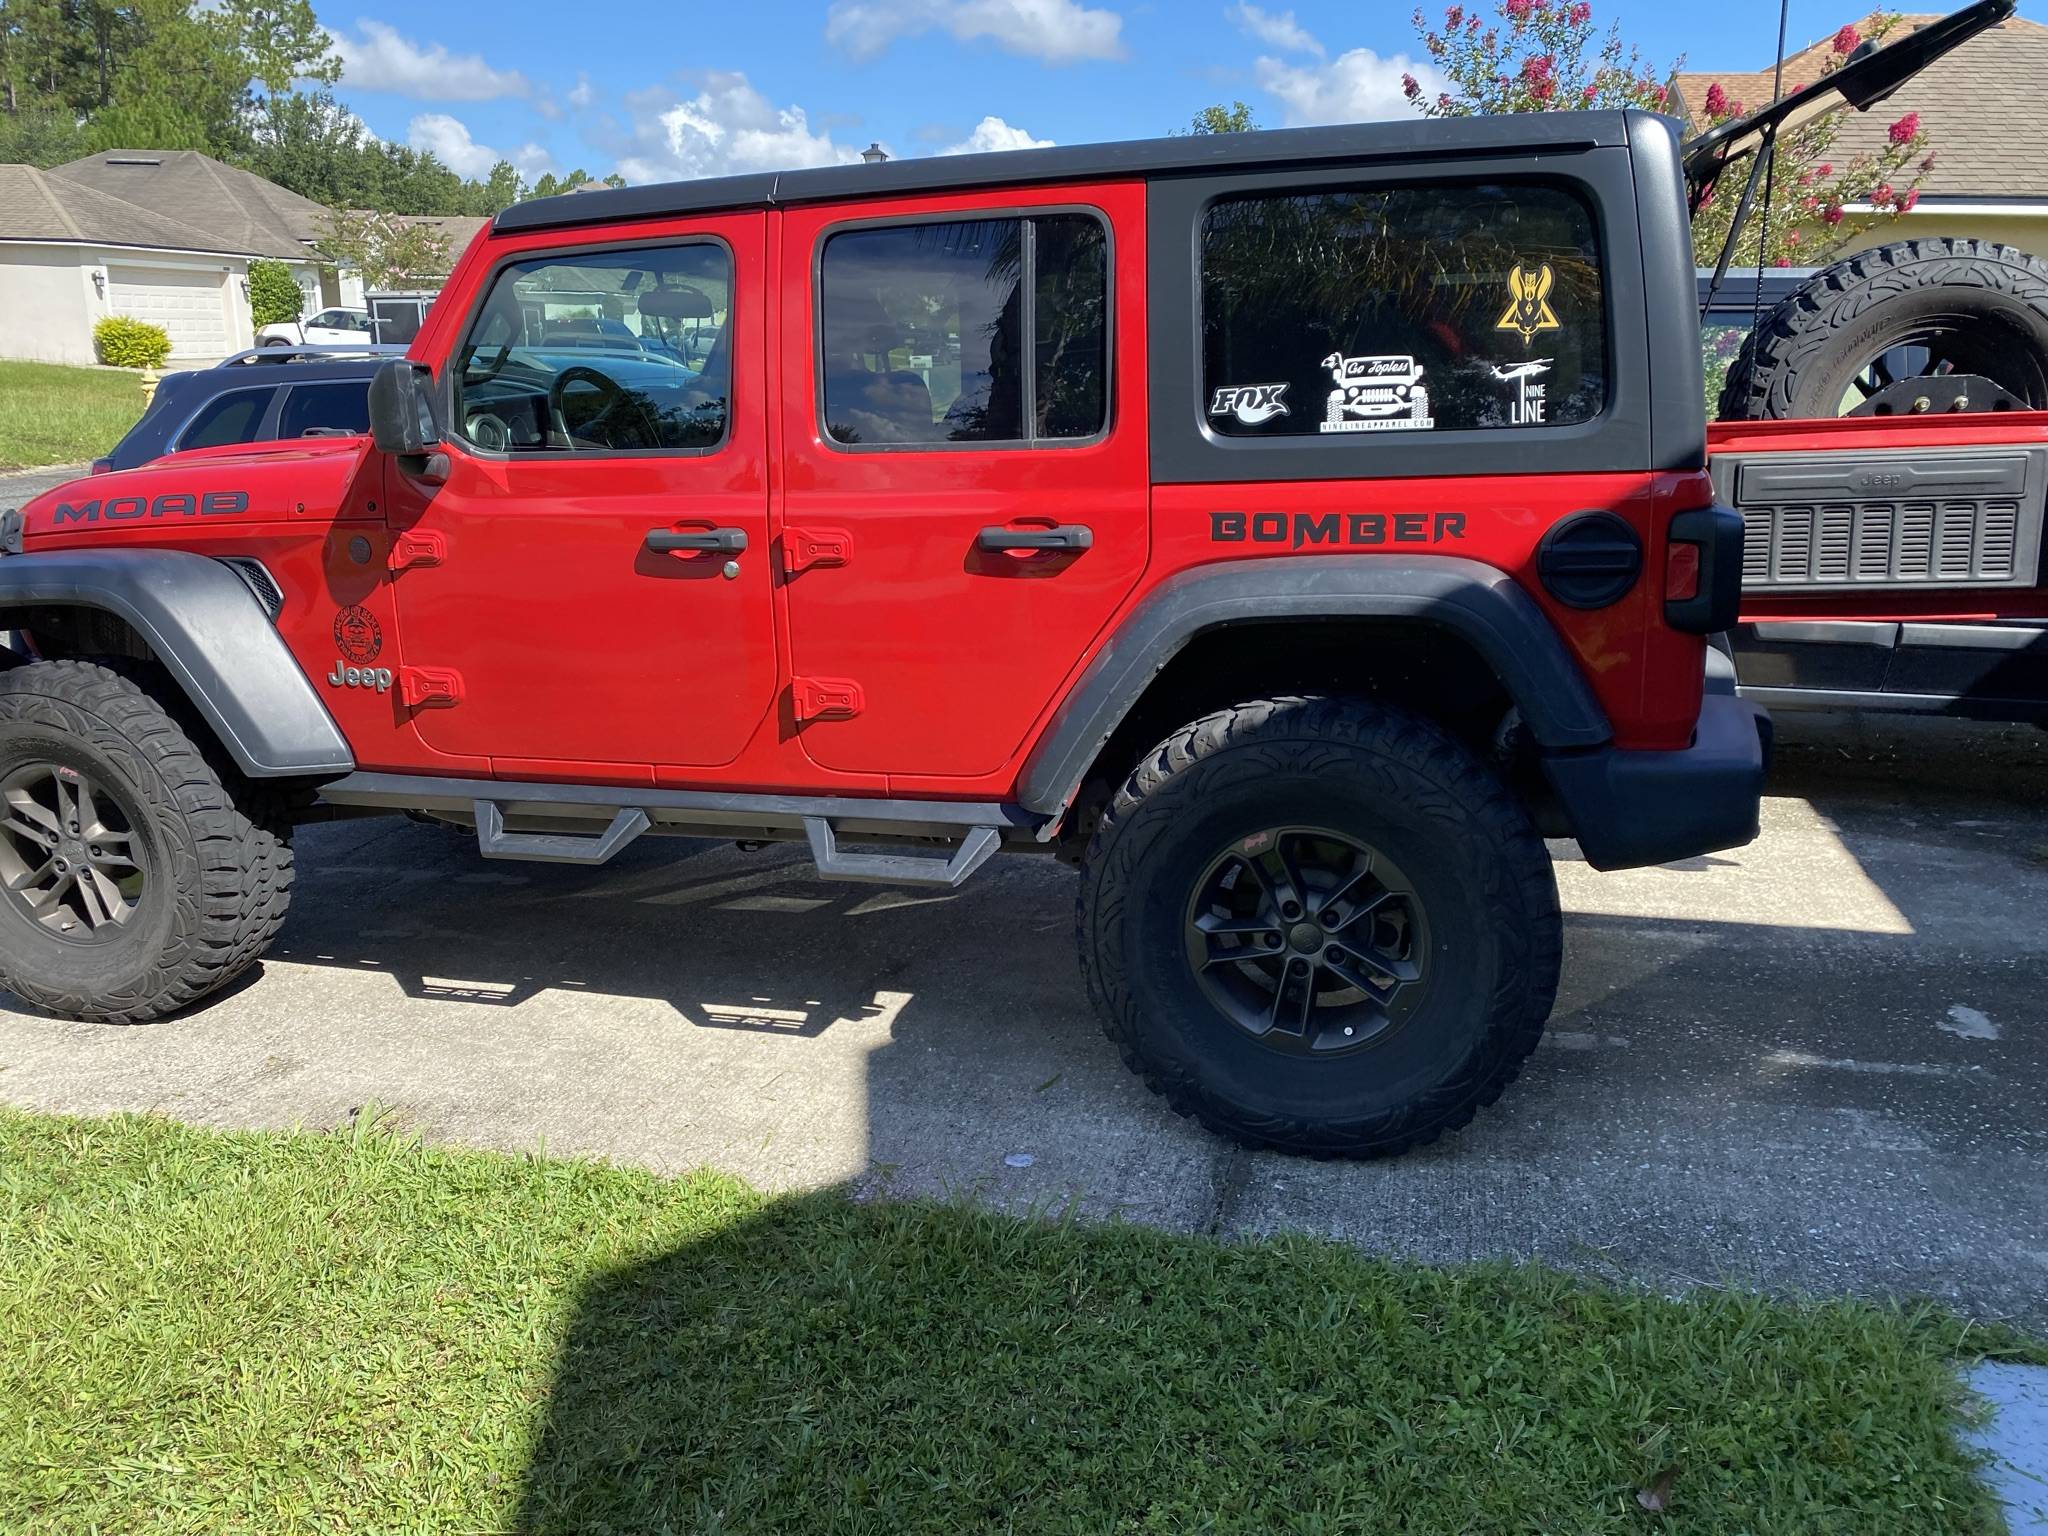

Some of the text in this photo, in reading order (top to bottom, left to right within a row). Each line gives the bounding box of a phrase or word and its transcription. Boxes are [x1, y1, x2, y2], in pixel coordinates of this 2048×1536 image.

[1347, 360, 1409, 376] Go Topless
[1211, 384, 1288, 416] FOX
[1525, 383, 1546, 398] NINE
[1511, 399, 1546, 424] LINE
[1860, 471, 1900, 489] Jeep
[53, 491, 250, 524] MOAB
[1208, 512, 1467, 551] BOMBER
[327, 660, 391, 693] Jeep
